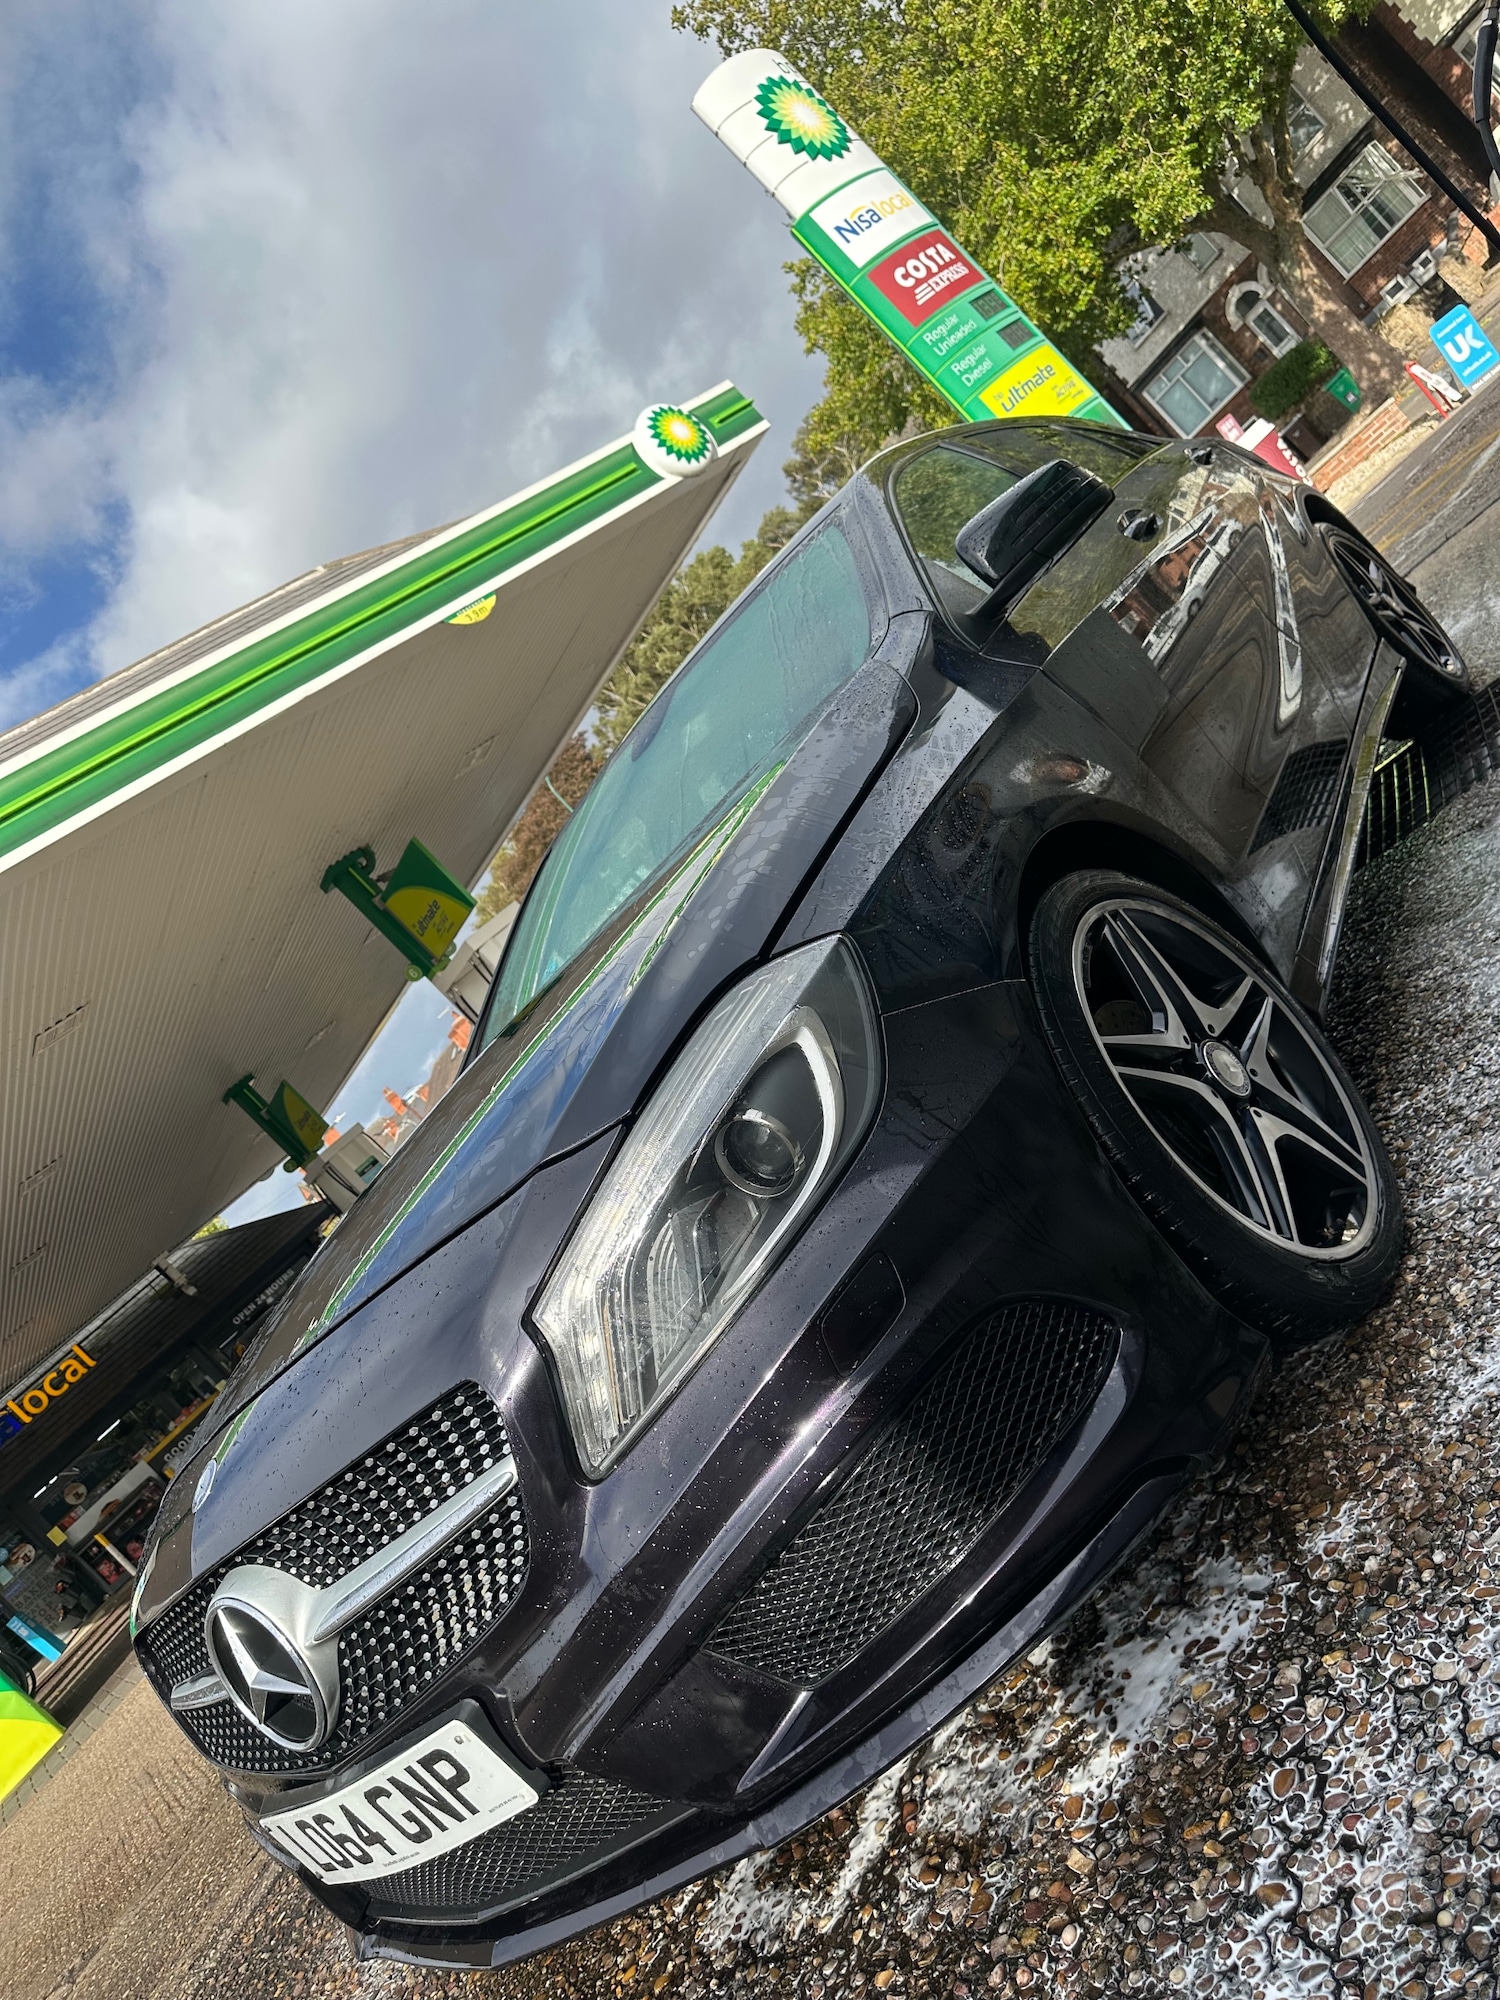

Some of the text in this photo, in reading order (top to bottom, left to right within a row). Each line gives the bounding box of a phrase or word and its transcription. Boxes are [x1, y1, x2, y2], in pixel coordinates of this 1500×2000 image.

[894, 243, 956, 288] COSTA
[927, 261, 970, 293] EXPRESS
[922, 314, 959, 346] Regular
[933, 319, 978, 356] Unleaded
[1443, 324, 1486, 364] UK
[951, 343, 987, 375] Regular
[961, 358, 993, 387] Diesel
[1001, 364, 1056, 413] ultimate
[464, 605, 489, 622] 3.9m
[416, 899, 441, 937] ultimate
[232, 1268, 295, 1325] OPEN 24 HOURS
[163, 1433, 195, 1463] GOOD
[15, 1574, 52, 1609] BAKER
[276, 1748, 481, 1873] LO64 GNP
